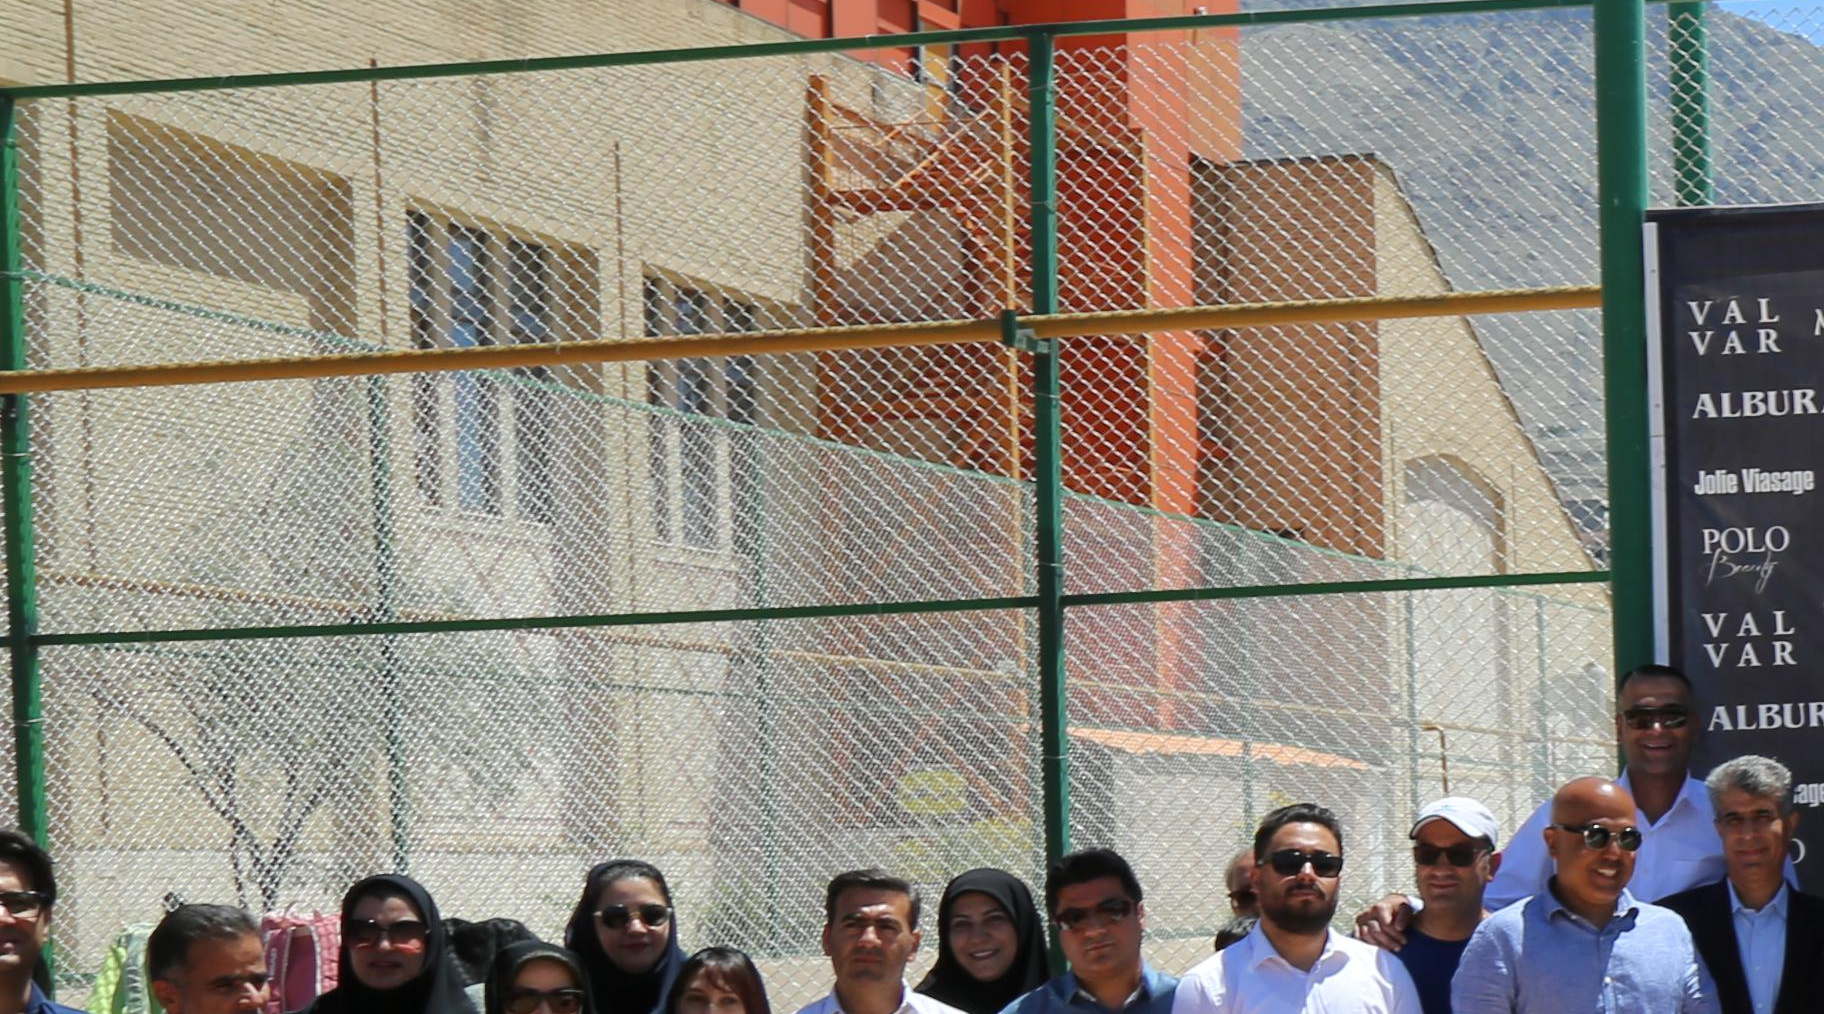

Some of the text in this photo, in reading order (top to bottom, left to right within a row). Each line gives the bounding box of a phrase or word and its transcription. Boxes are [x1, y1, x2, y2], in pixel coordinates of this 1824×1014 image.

[1693, 467, 1815, 495] Jolie Viasage
[1702, 525, 1790, 556] POLO
